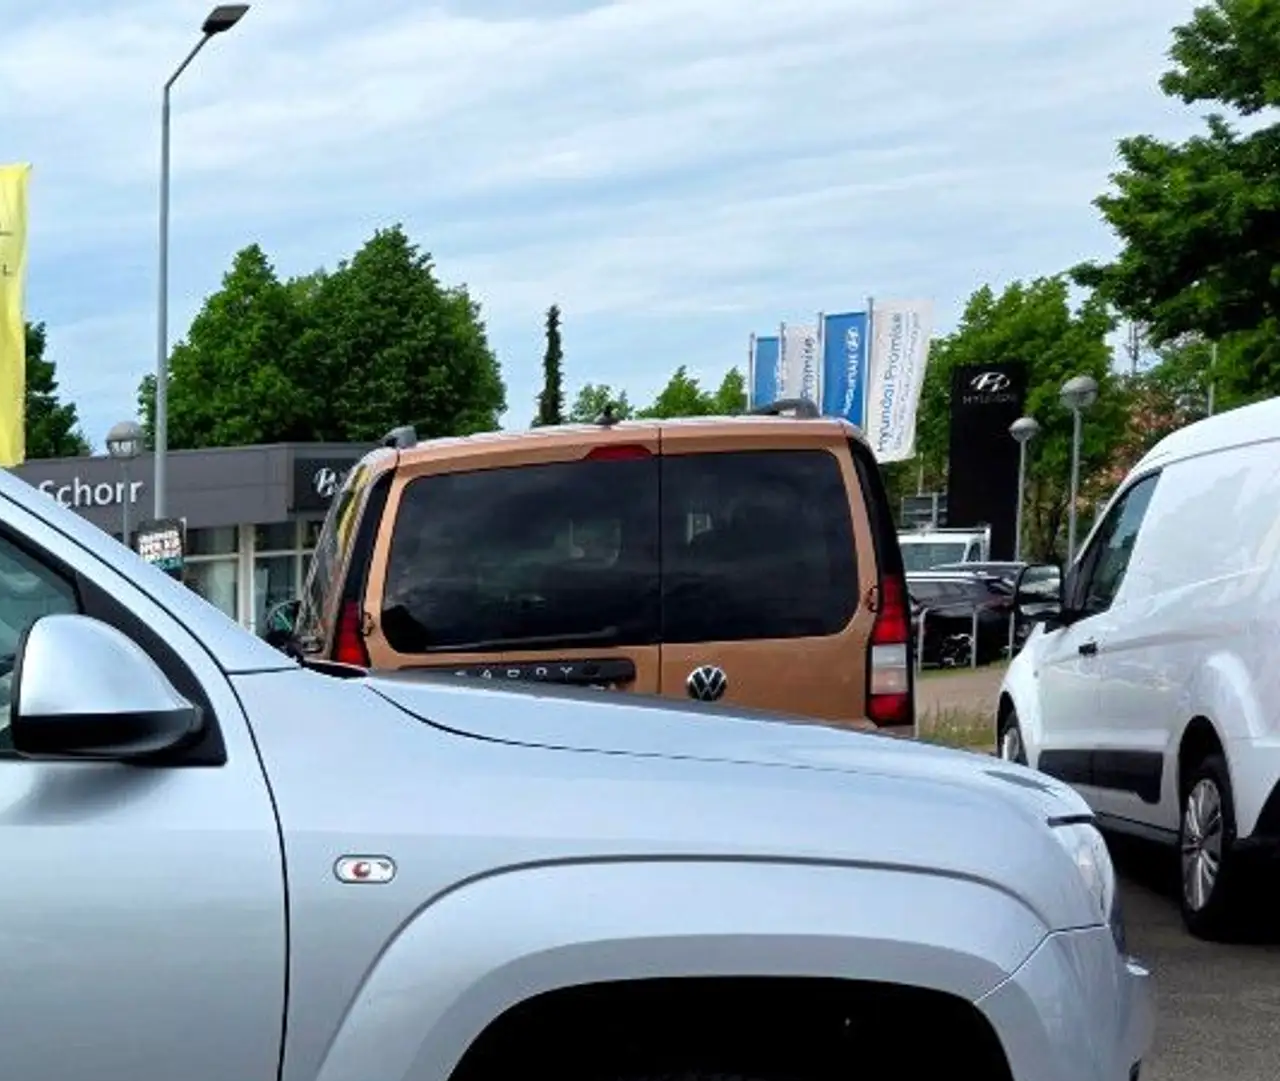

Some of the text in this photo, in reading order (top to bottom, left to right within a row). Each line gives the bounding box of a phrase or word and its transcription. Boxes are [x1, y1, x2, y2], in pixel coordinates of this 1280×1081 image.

[876, 313, 902, 452] Hyundai Promise
[39, 476, 144, 508] Schorr
